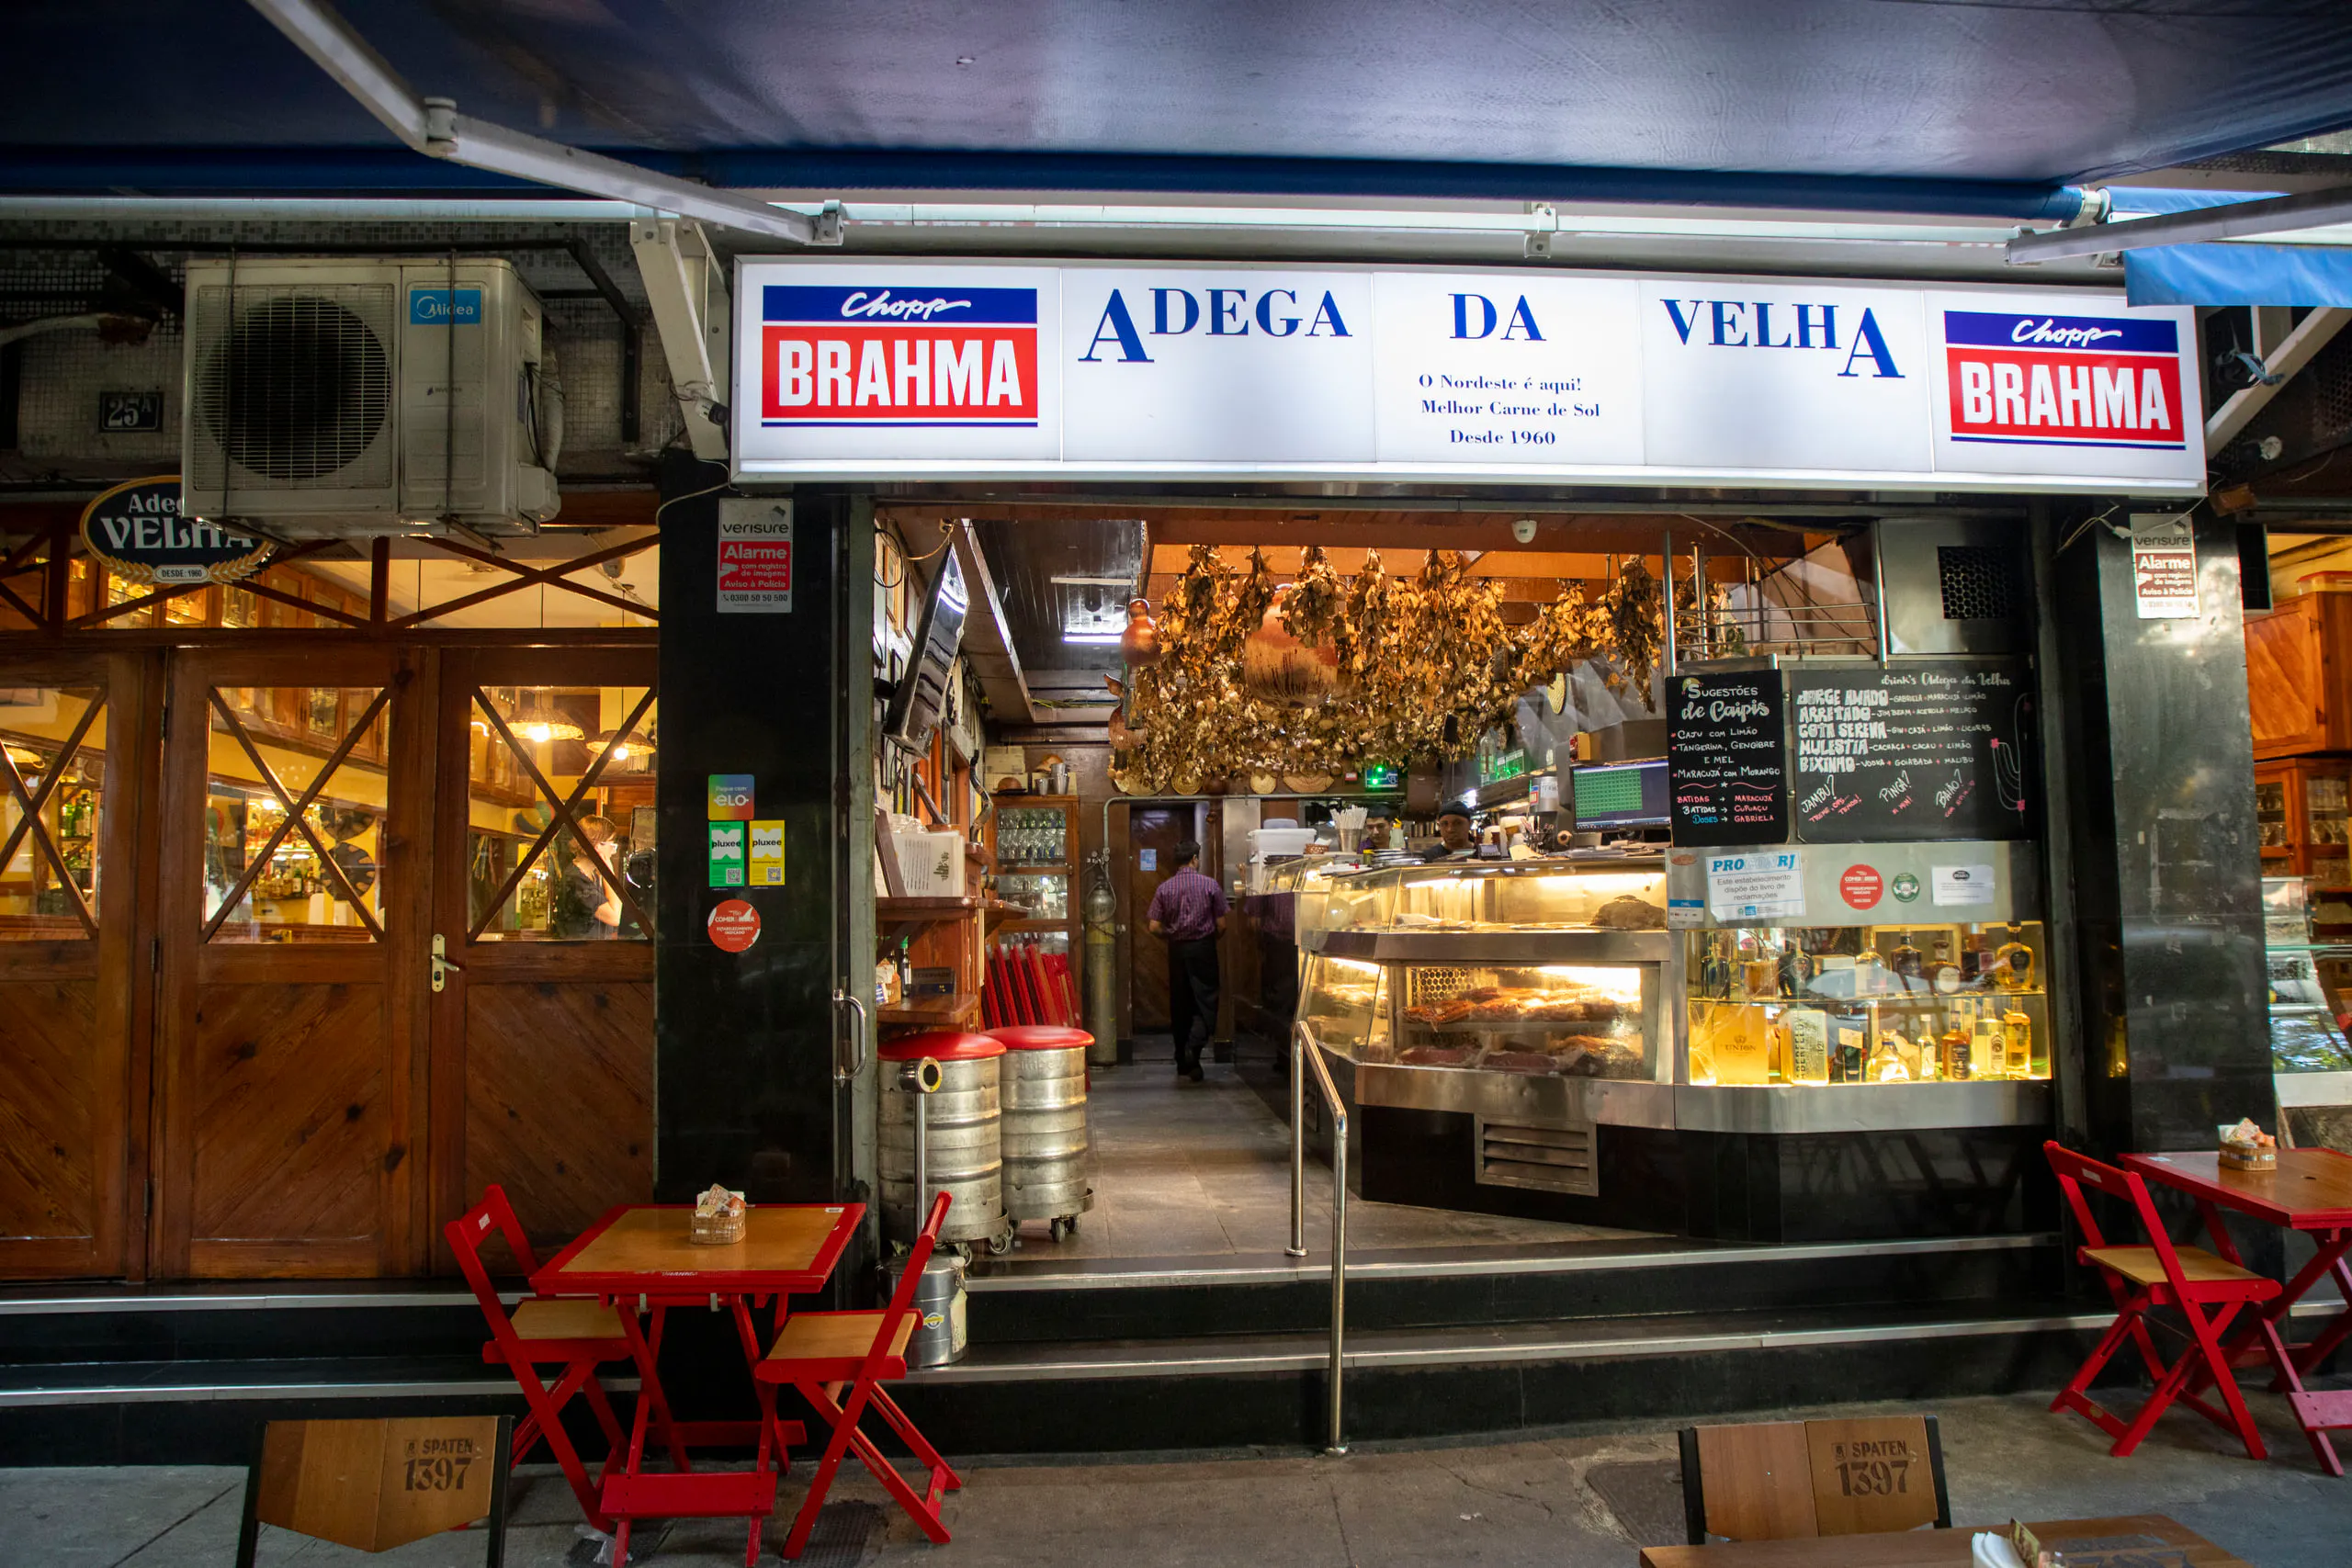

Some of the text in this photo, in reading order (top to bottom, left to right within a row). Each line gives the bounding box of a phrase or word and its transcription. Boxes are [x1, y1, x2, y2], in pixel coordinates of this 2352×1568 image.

[841, 289, 972, 321] Chopp
[1077, 288, 1905, 378] ADEGA DA VELHA
[2011, 318, 2122, 348] Chopp
[777, 339, 1023, 407] BRAHMA
[1419, 374, 1581, 394] O Nordeste é aqui!
[1961, 361, 2171, 432] BRAHMA
[1421, 400, 1600, 417] Melhor Carne de Sol
[1450, 429, 1555, 445] Desde 1960
[722, 524, 789, 534] verisure
[2134, 536, 2190, 546] verisure
[724, 544, 787, 559] Alarme
[758, 562, 787, 570] registro
[2139, 555, 2191, 570] Alarme
[187, 570, 202, 578] 1960
[758, 580, 786, 588] Polícia
[1688, 683, 1758, 699] SUGESTÕES
[1797, 688, 1841, 705] JORGE
[1844, 689, 1889, 706] AMADO
[1681, 699, 1770, 723] de Caipis
[1799, 705, 1871, 723] ARRETADO
[1677, 730, 1702, 739] CAJU
[1730, 727, 1758, 736] LIMÃO
[1838, 721, 1888, 739] SERENA
[1731, 740, 1775, 750] GENGIBRE
[1678, 767, 1722, 779] MARACUJÁ
[1740, 765, 1781, 776] MORANGO
[1677, 793, 1773, 804] BATIDAS MARACUJÁ
[1692, 814, 1774, 824] DOSES GABRIELA
[712, 840, 741, 849] pluxee
[752, 839, 782, 848] pluxee
[1735, 874, 1792, 885] estabelecimento
[1724, 885, 1747, 895] dispõe
[1749, 884, 1758, 892] do
[1733, 892, 1778, 901] reclamações
[423, 1438, 473, 1454] SPATEN
[1852, 1440, 1907, 1458] SPATEN
[403, 1457, 472, 1491] 1397
[1835, 1461, 1910, 1497] 1397
